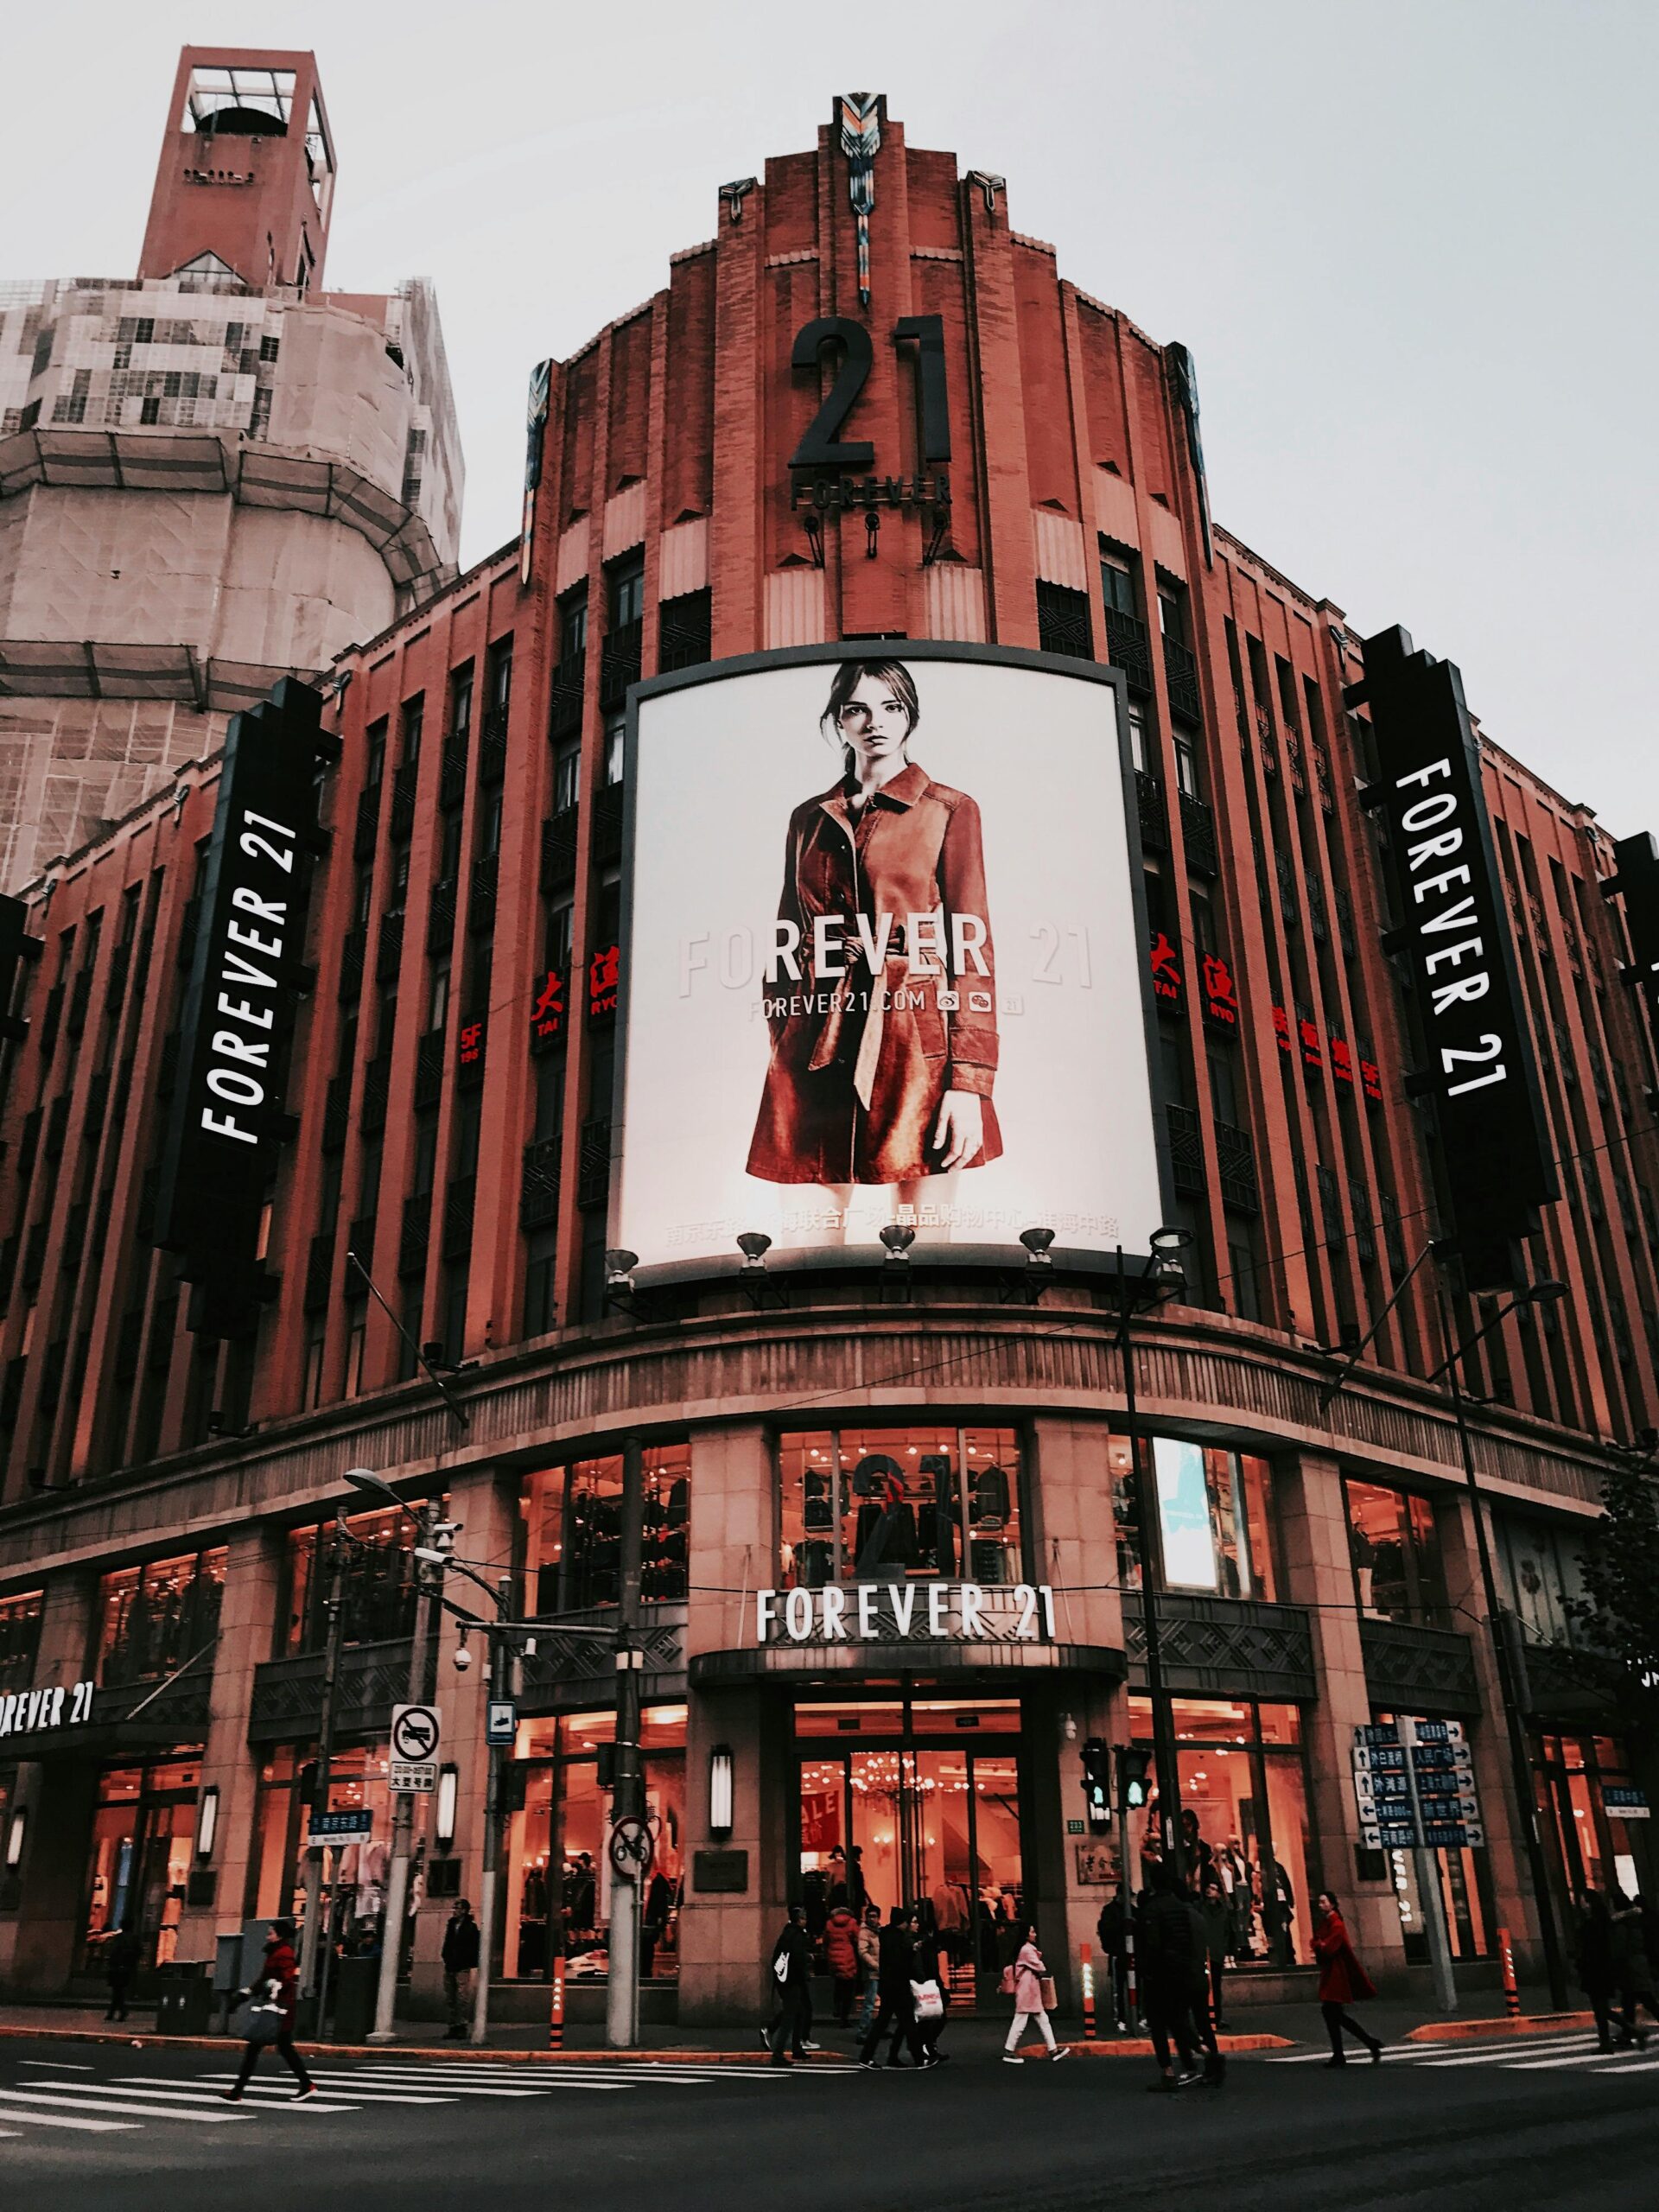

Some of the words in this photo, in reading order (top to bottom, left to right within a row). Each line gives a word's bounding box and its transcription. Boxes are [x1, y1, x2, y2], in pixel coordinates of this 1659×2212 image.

[788, 315, 951, 469] 21
[791, 474, 952, 512] FOREVER
[240, 810, 295, 873] 21
[1396, 759, 1489, 1014] FOREVER
[680, 912, 990, 1001] FOREVER
[1030, 920, 1092, 989] 21
[202, 887, 286, 1143] FOREVER
[537, 1018, 558, 1036] TAI
[751, 991, 925, 1021] FOREVER21.COM
[461, 1023, 481, 1048] 5F
[1441, 1034, 1506, 1096] 21
[852, 1454, 953, 1579] 21
[758, 1584, 985, 1641] FOREVER
[1015, 1584, 1056, 1637] 21
[70, 1681, 93, 1724] 21
[1417, 1748, 1452, 1764] 人民广场
[1424, 1801, 1460, 1817] 新世界
